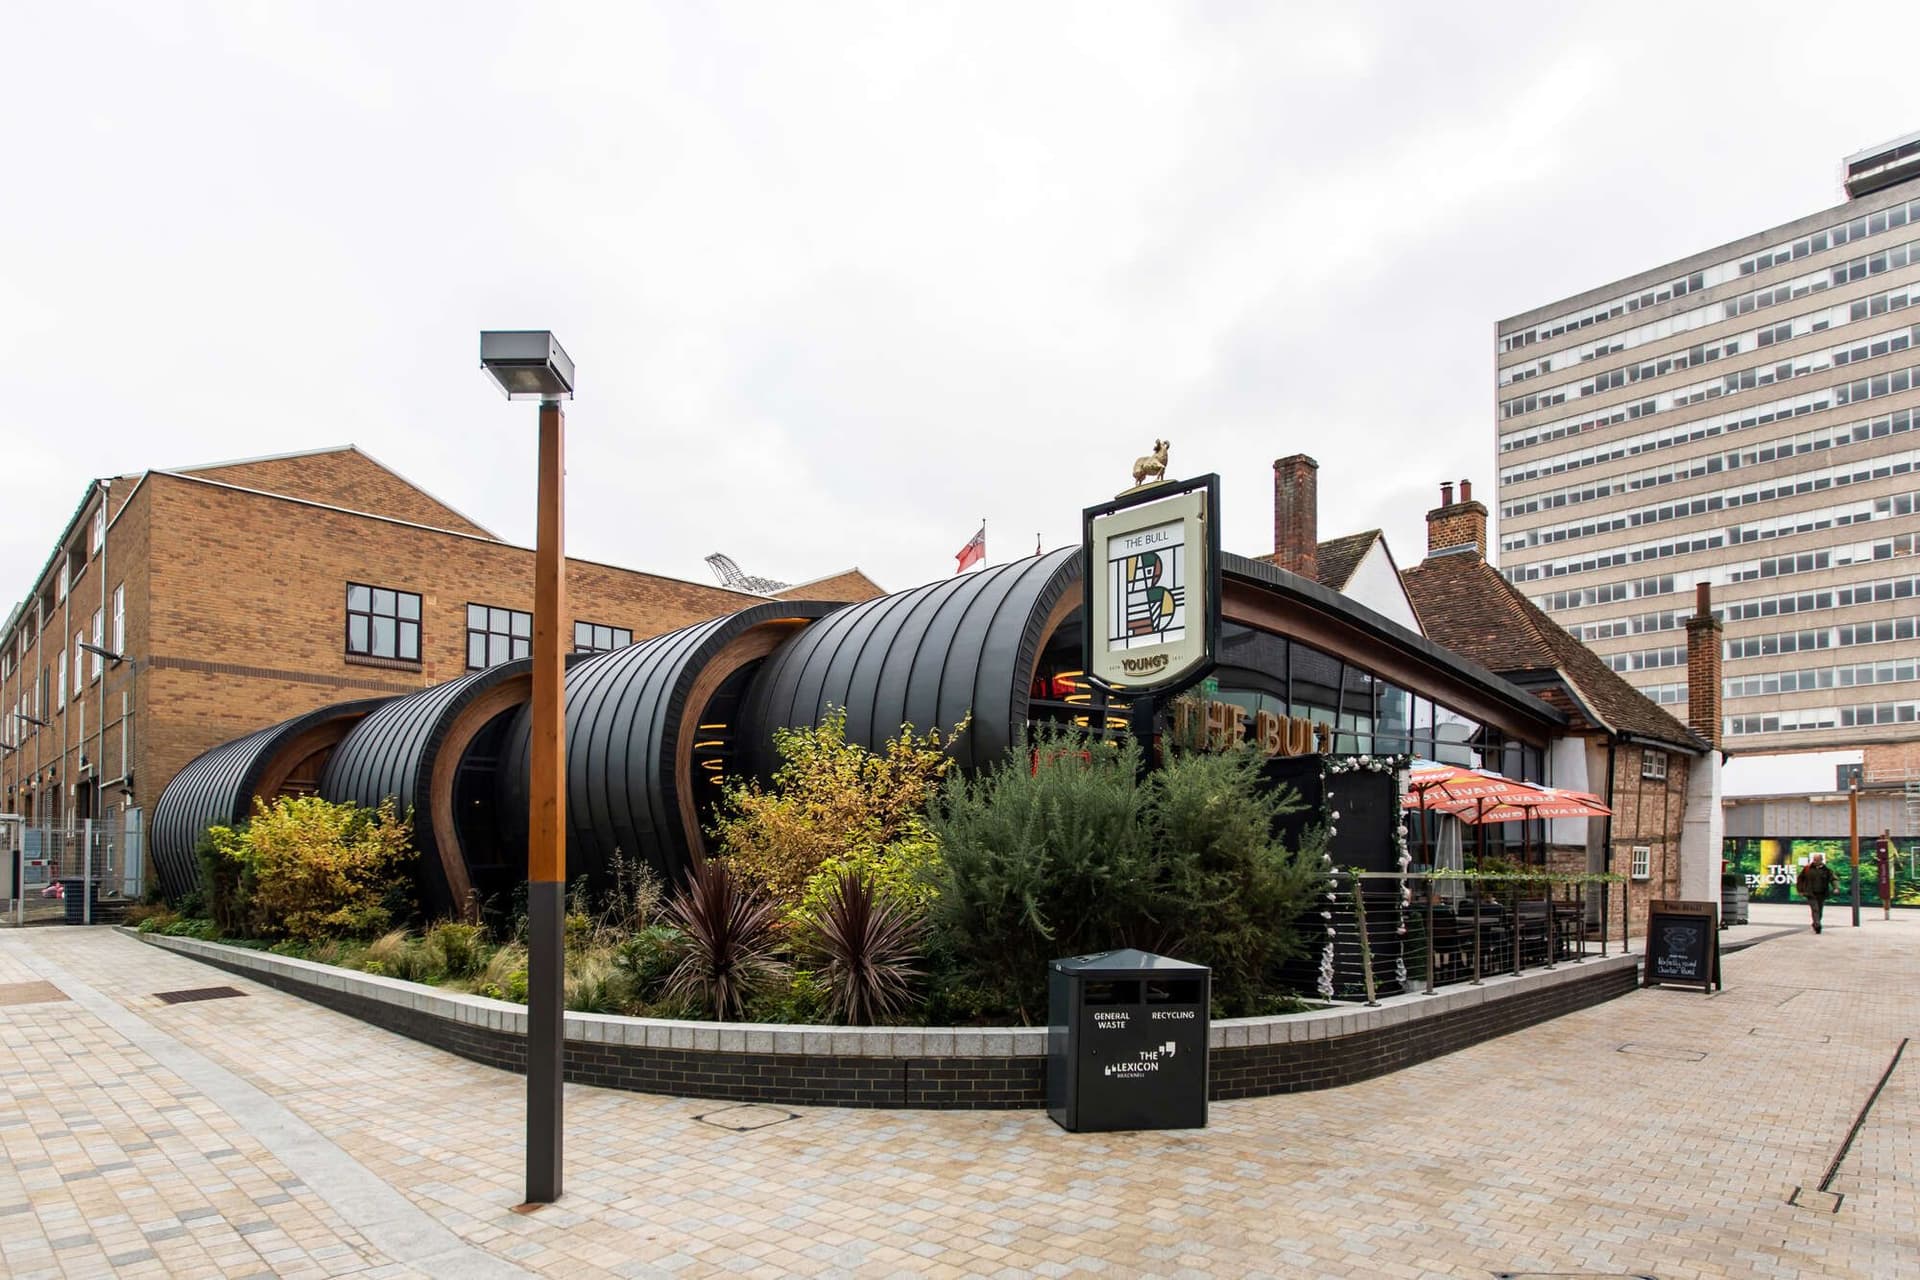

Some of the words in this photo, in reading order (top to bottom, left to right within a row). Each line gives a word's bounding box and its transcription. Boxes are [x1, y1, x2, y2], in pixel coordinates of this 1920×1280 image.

[1125, 535, 1143, 549] THE
[1145, 530, 1169, 545] BULL
[1121, 653, 1169, 671] YOUNG'S
[1174, 696, 1247, 751] THE
[1256, 709, 1334, 757] BULL
[1767, 864, 1797, 875] THE
[1744, 874, 1798, 885] EXICON
[1094, 1012, 1130, 1020] GENERAL
[1152, 1011, 1195, 1019] RECYCLING
[1098, 1021, 1126, 1029] WASTE
[1140, 1051, 1158, 1060] THE
[1117, 1062, 1159, 1072] LEXICON
